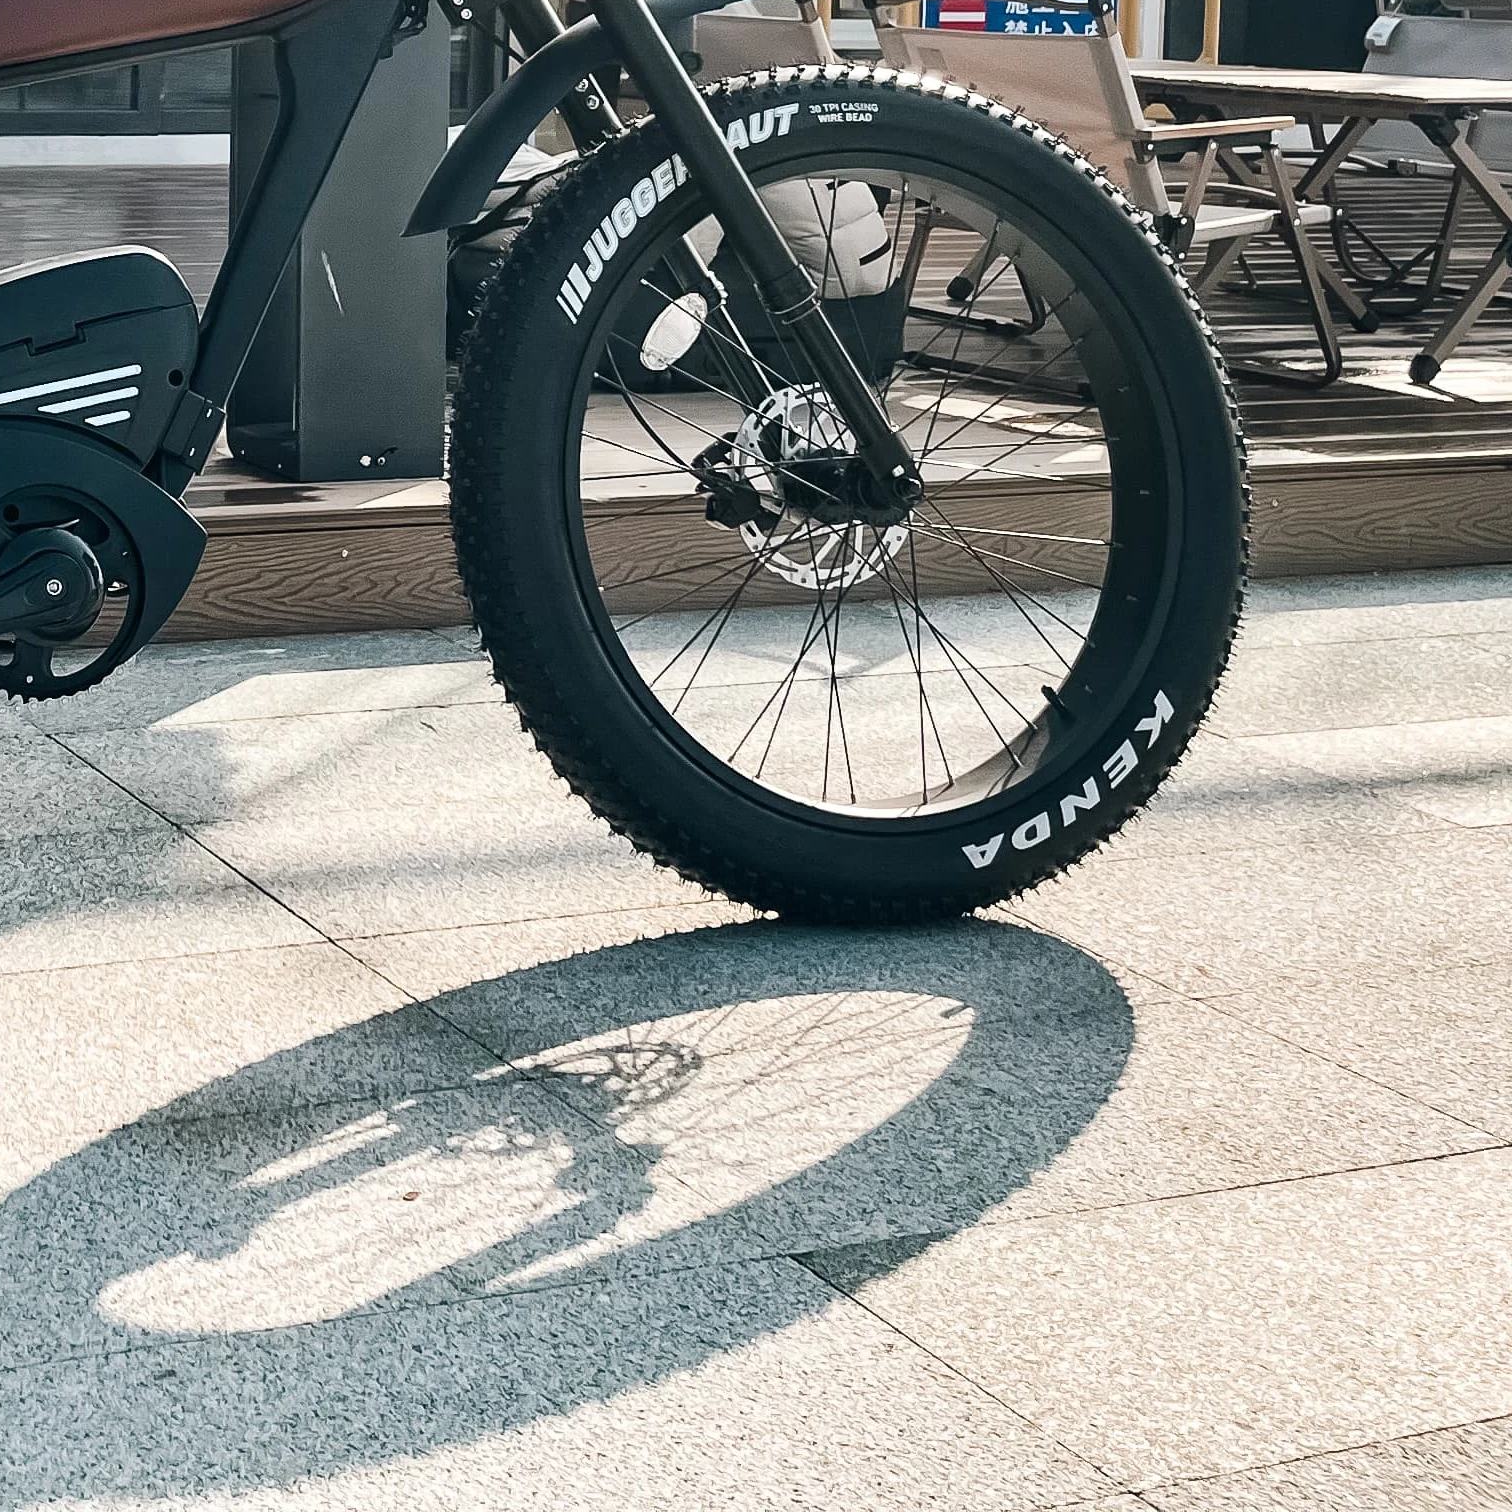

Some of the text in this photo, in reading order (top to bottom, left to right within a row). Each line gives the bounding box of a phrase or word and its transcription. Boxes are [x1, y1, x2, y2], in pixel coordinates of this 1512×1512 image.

[840, 102, 879, 113] CASING
[817, 112, 873, 123] WIRE BEAD
[961, 689, 1175, 869] KENDA
